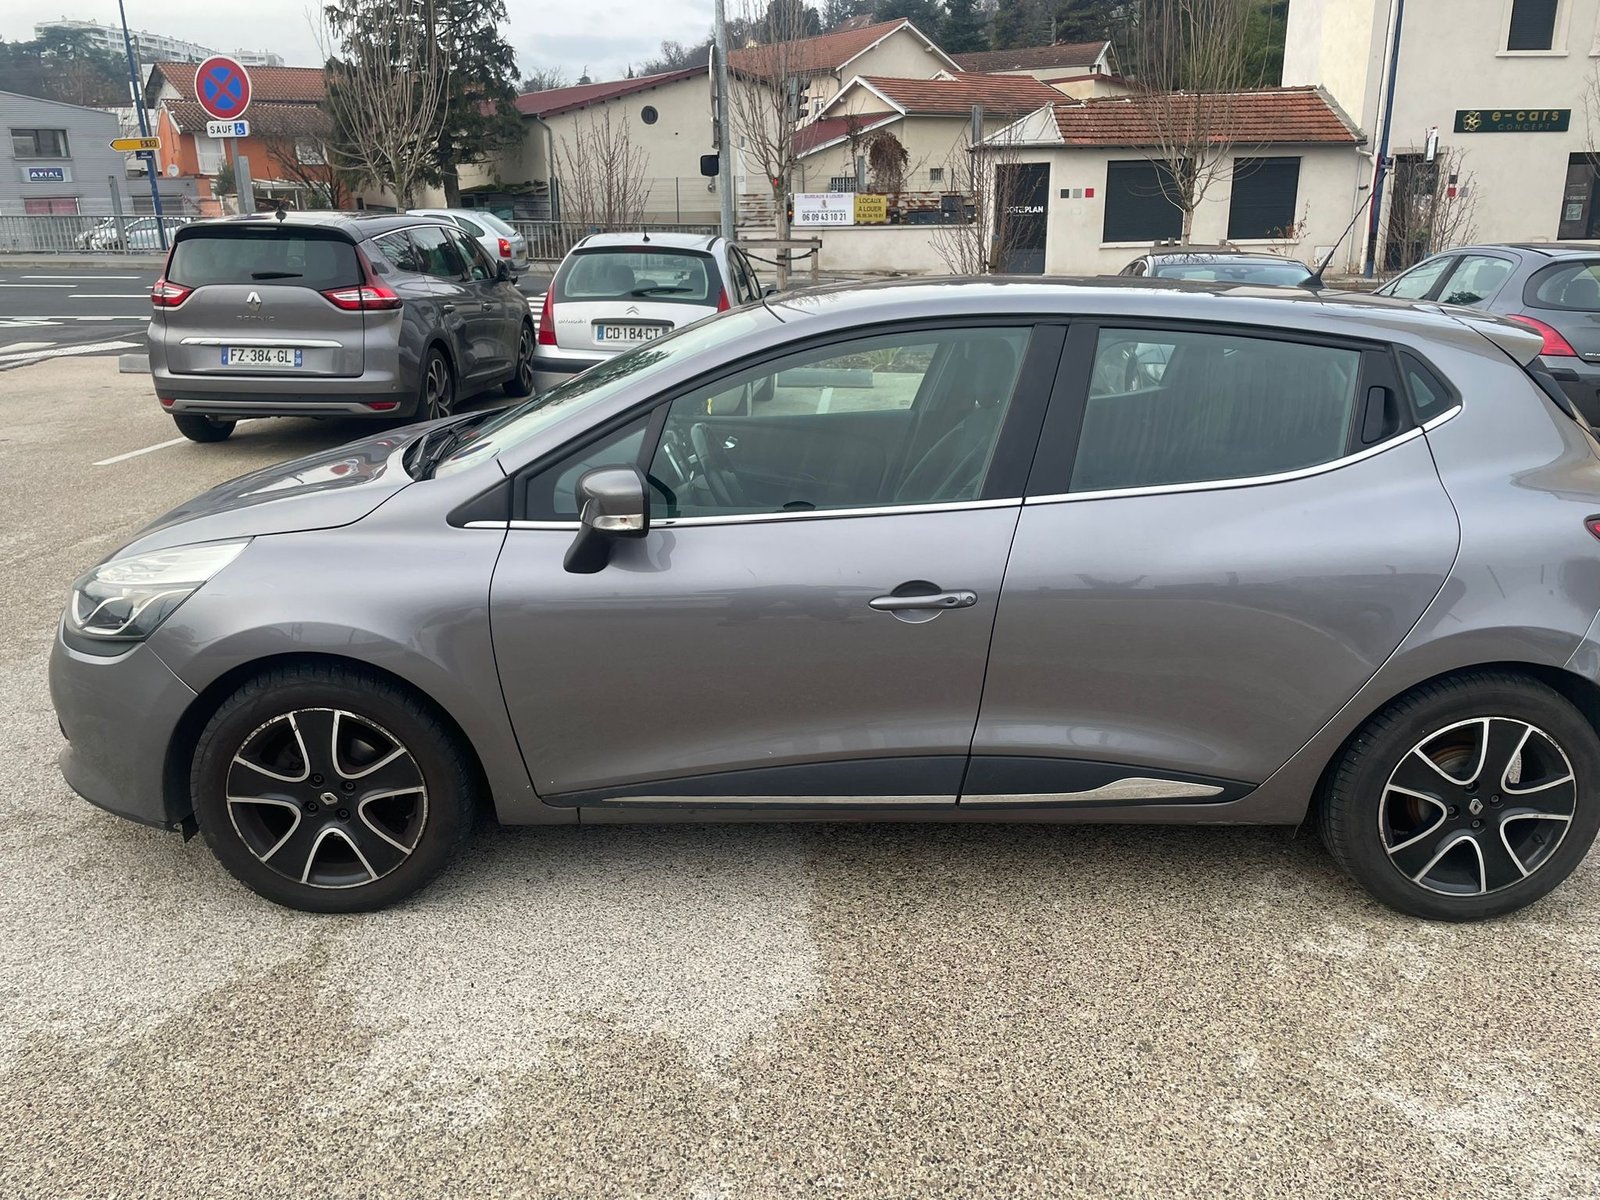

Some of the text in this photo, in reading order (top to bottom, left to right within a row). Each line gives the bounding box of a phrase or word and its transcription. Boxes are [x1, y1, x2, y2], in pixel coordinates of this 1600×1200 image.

[1491, 111, 1559, 121] e-cars
[209, 124, 232, 134] SAUF
[1497, 123, 1551, 131] CONCEPT
[802, 213, 810, 221] 06
[839, 213, 847, 221] 21
[230, 348, 292, 363] FZ-384-GL
